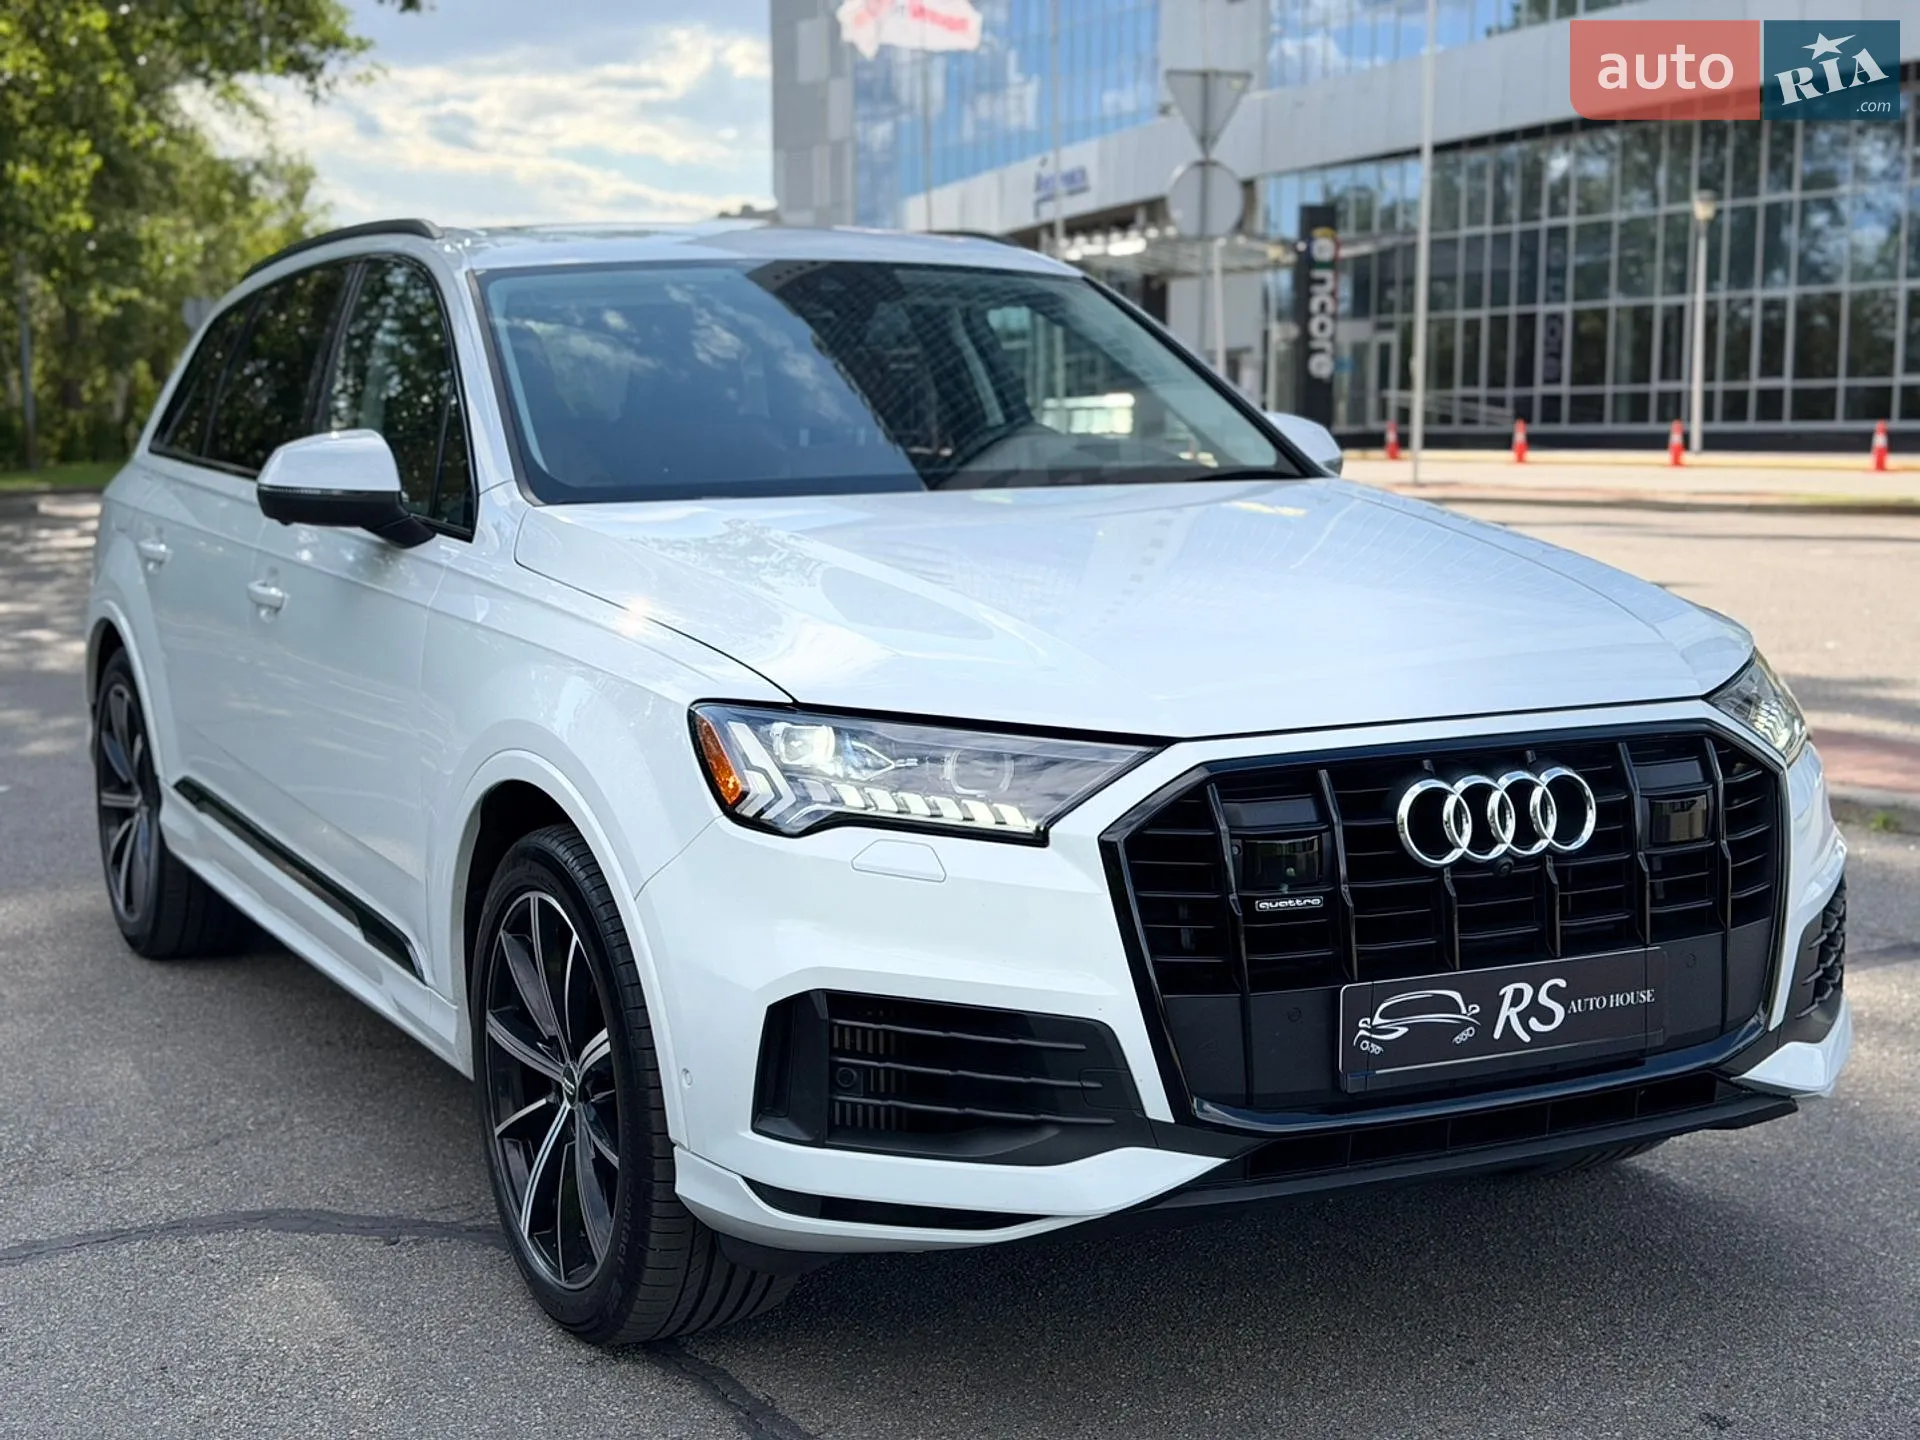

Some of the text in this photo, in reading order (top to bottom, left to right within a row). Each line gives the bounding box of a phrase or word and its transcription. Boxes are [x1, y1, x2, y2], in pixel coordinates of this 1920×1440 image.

[1308, 236, 1336, 380] encore
[1259, 898, 1321, 910] quattro
[1493, 978, 1655, 1042] RS AUTO HOUSE
